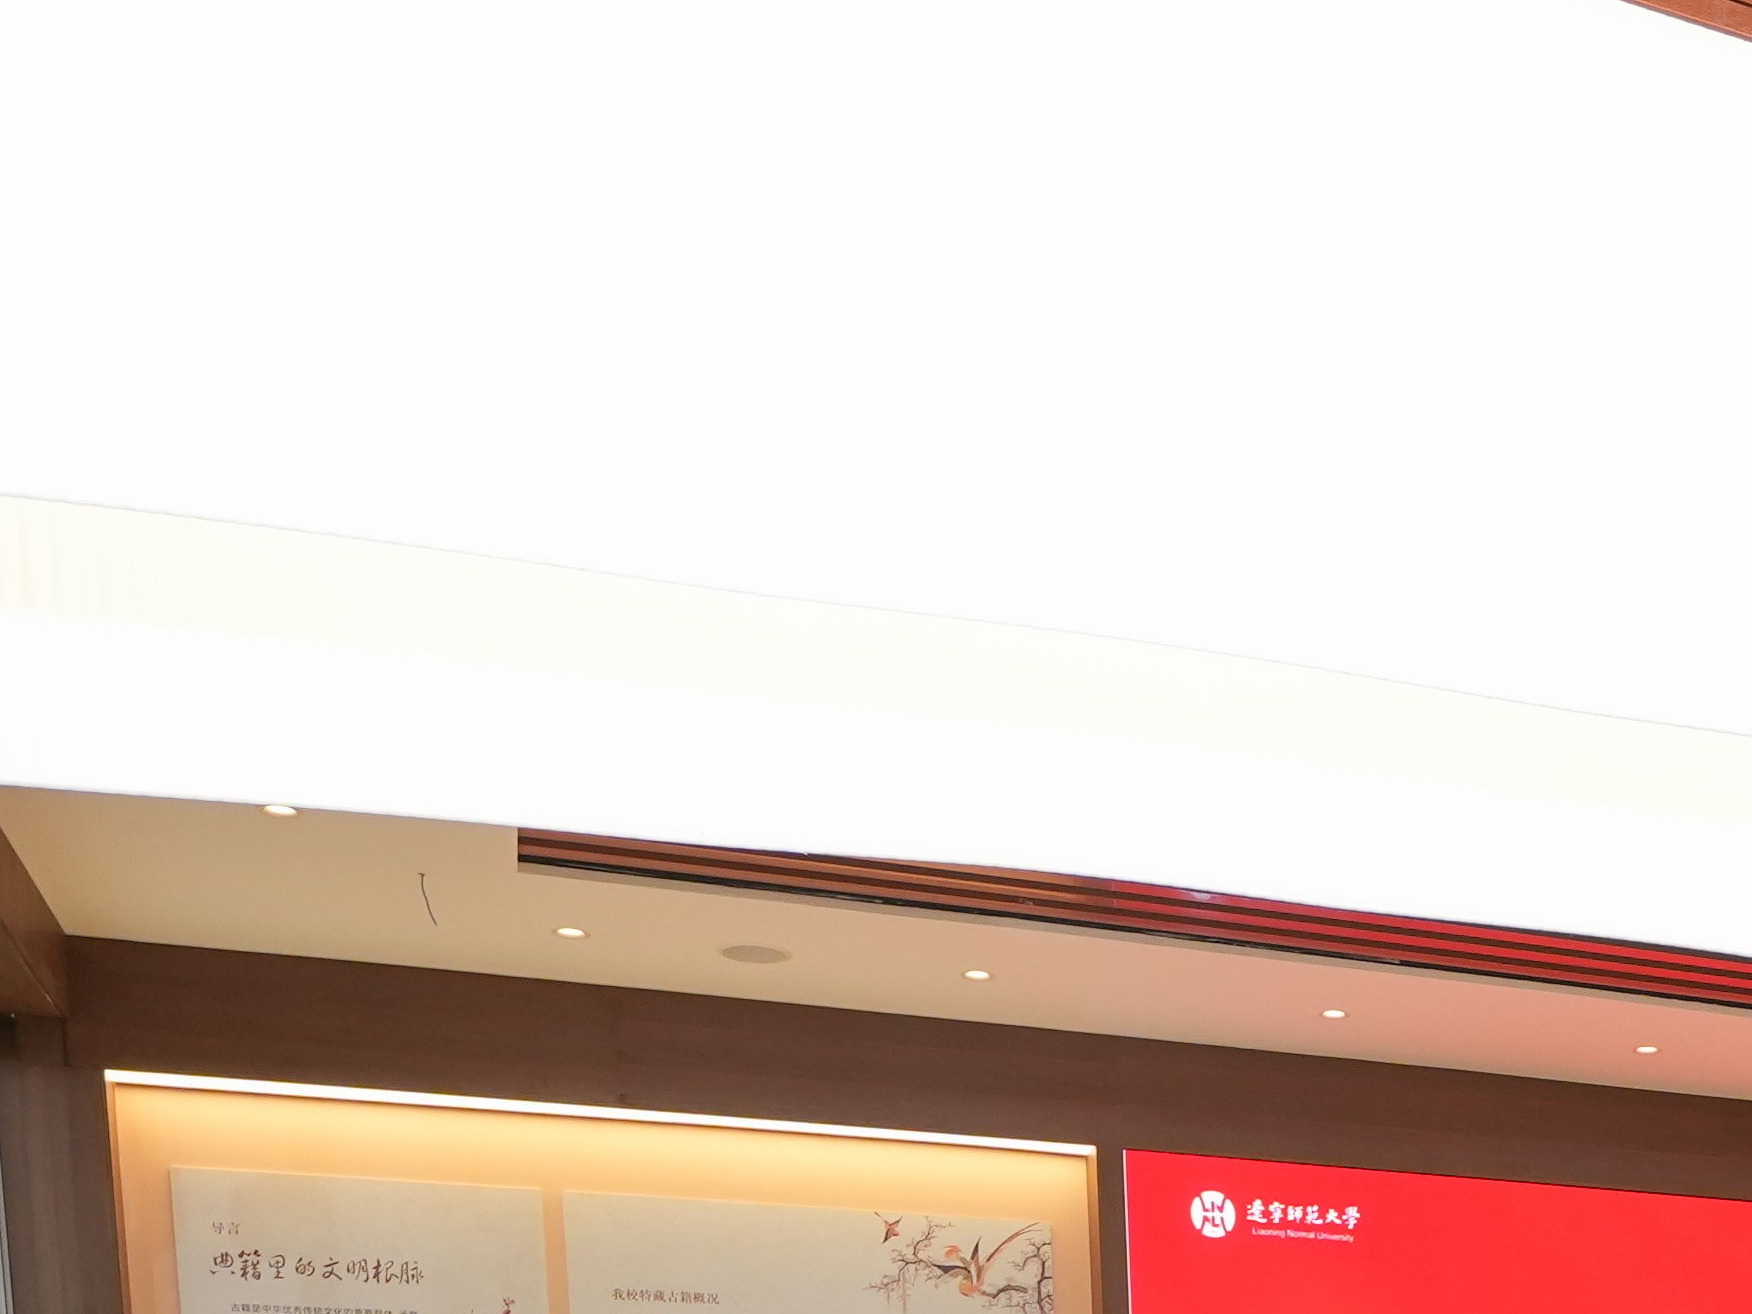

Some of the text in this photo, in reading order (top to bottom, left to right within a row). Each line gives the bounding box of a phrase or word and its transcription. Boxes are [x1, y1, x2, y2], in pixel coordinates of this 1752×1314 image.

[212, 1221, 240, 1236] 导言
[209, 1249, 425, 1285] 典籍里的文明根脉
[611, 1287, 720, 1305] 我校特藏古籍概况
